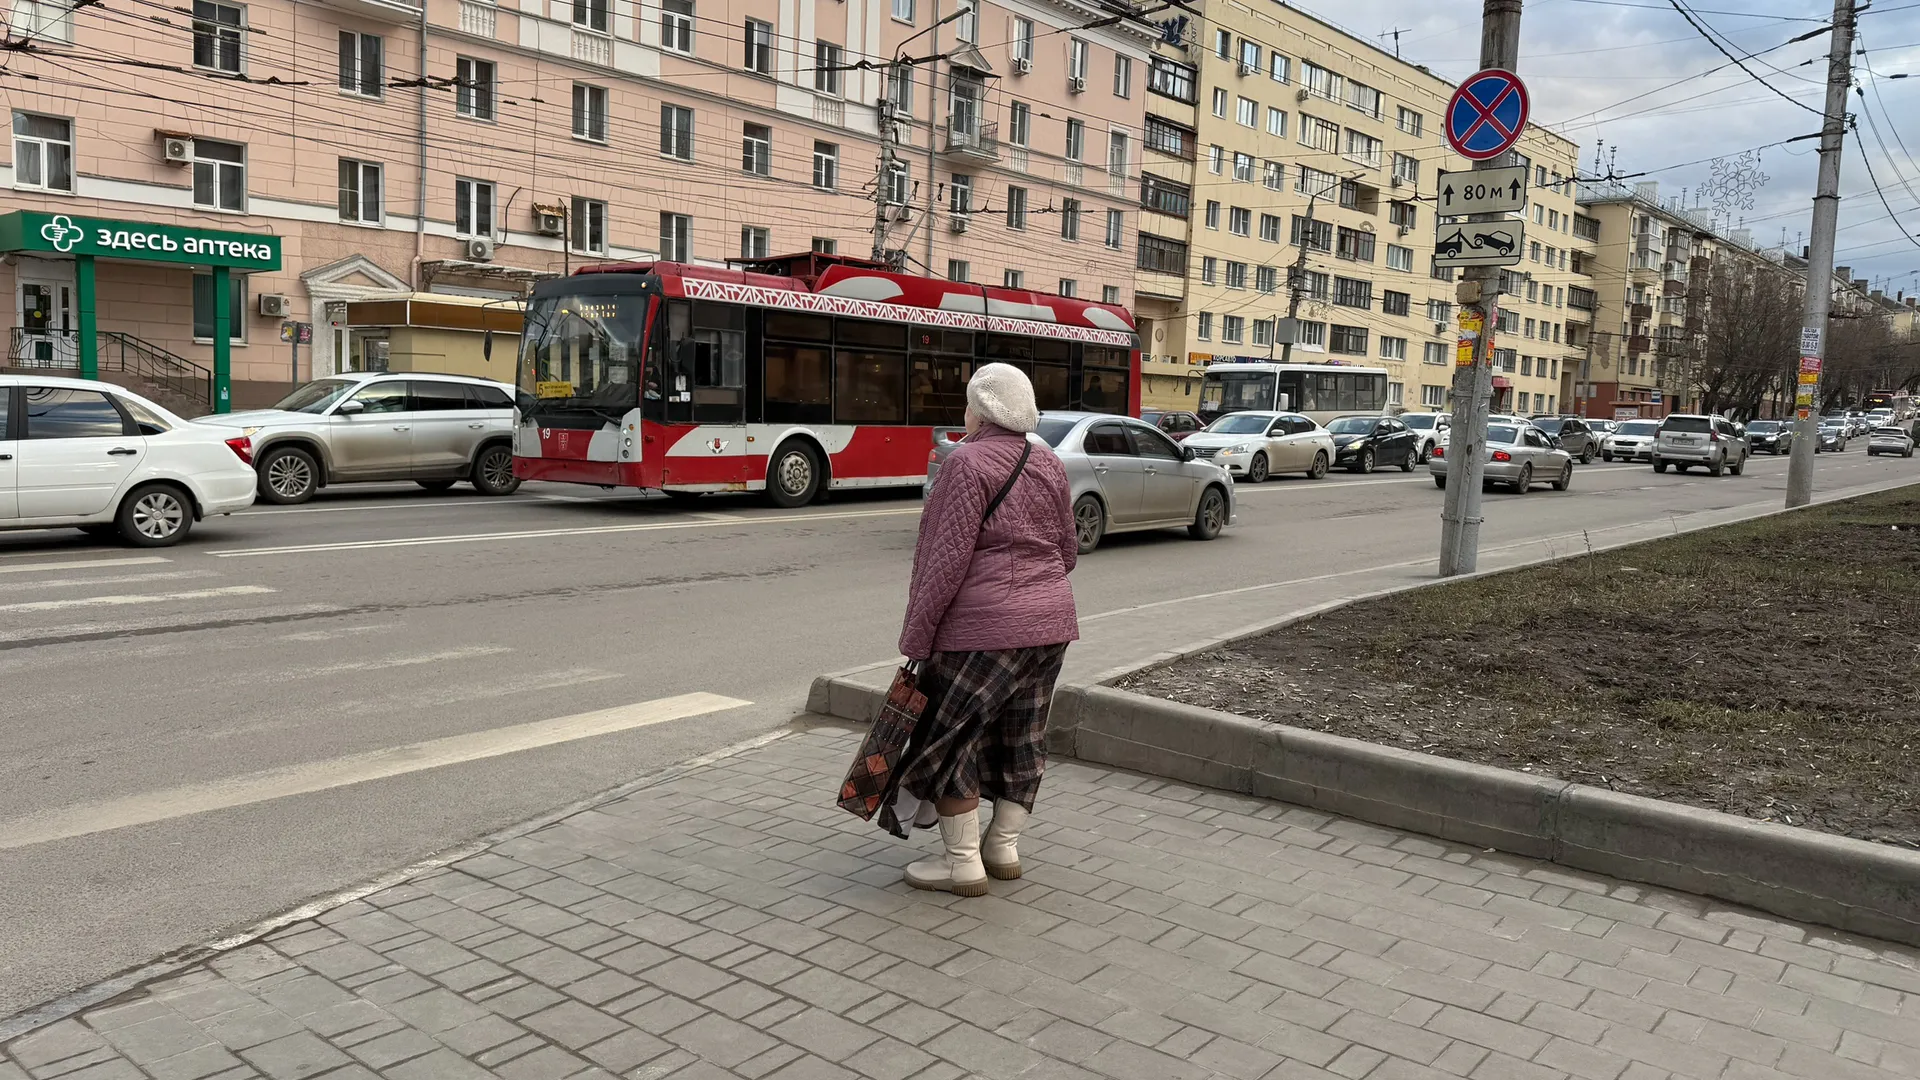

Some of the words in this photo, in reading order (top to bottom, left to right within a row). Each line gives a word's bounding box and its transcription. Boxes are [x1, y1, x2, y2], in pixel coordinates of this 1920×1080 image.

[1463, 184, 1486, 201] 80
[96, 228, 178, 252] здесь
[183, 236, 272, 261] аптека
[921, 334, 930, 345] 19
[538, 383, 544, 396] 5
[542, 427, 551, 440] 19
